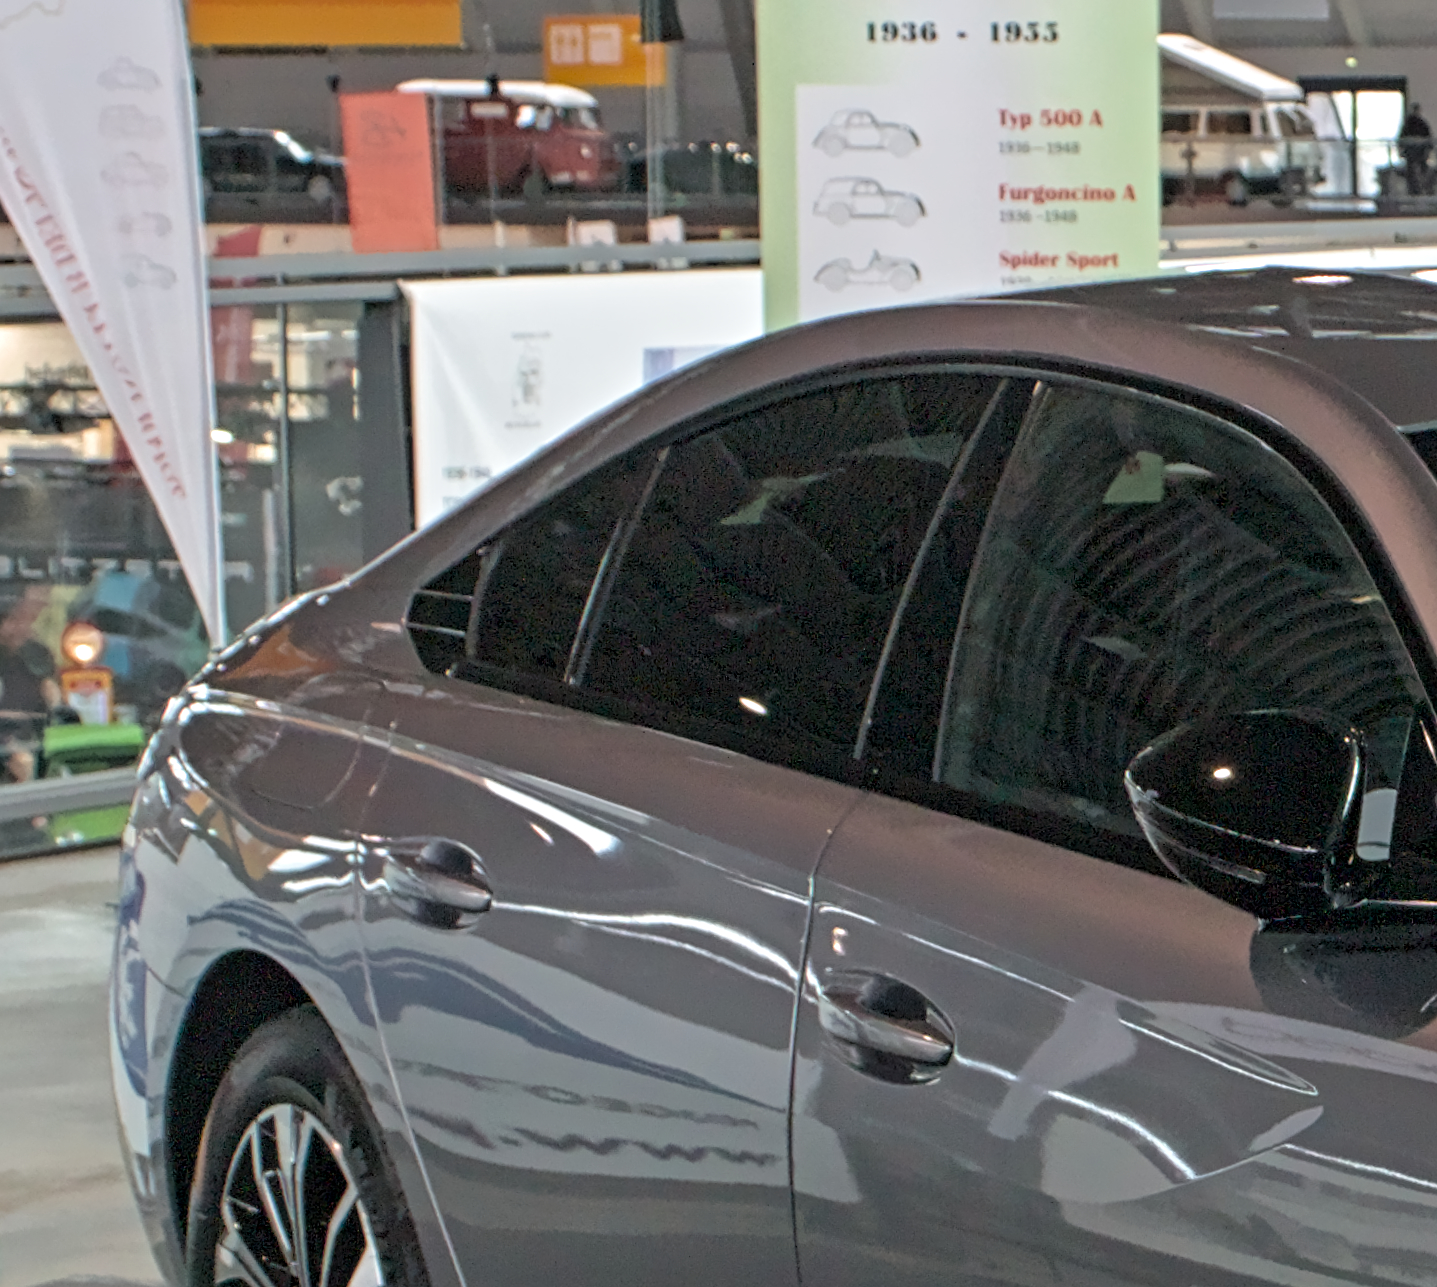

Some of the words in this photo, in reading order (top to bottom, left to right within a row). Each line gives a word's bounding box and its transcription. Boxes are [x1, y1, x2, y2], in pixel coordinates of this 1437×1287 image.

[866, 20, 938, 43] 1936
[990, 20, 1059, 43] 1955
[998, 108, 1032, 131] Typ
[1040, 108, 1083, 128] 500
[1089, 108, 1103, 128] A
[999, 183, 1116, 205] Furgoncino
[1123, 184, 1137, 202] A
[999, 251, 1060, 271] Spider
[1066, 251, 1119, 272] Sport
